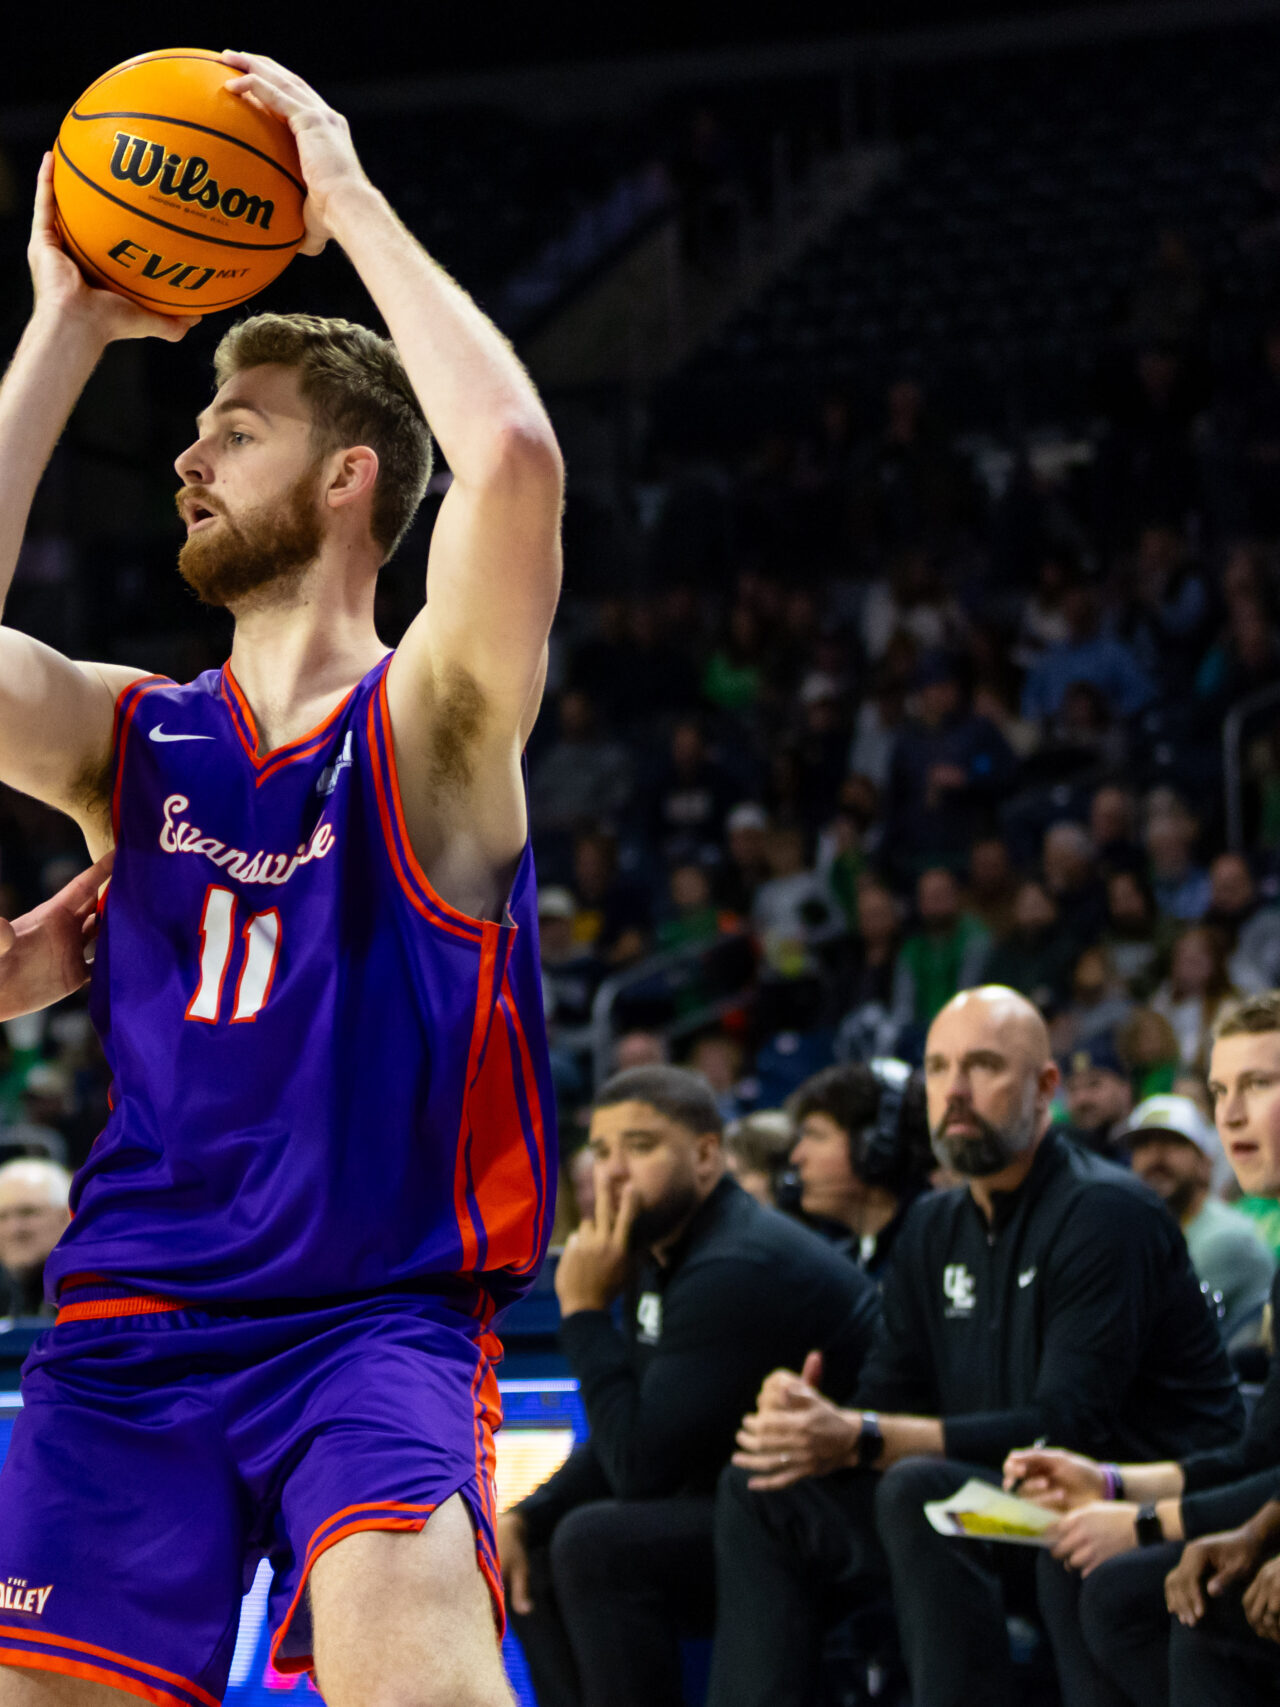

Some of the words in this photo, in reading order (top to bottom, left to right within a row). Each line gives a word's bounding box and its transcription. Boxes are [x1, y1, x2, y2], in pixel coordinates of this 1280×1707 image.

[110, 132, 276, 230] Wilson
[107, 239, 217, 291] EVO
[184, 883, 282, 1026] 11
[7, 1577, 28, 1587] THE
